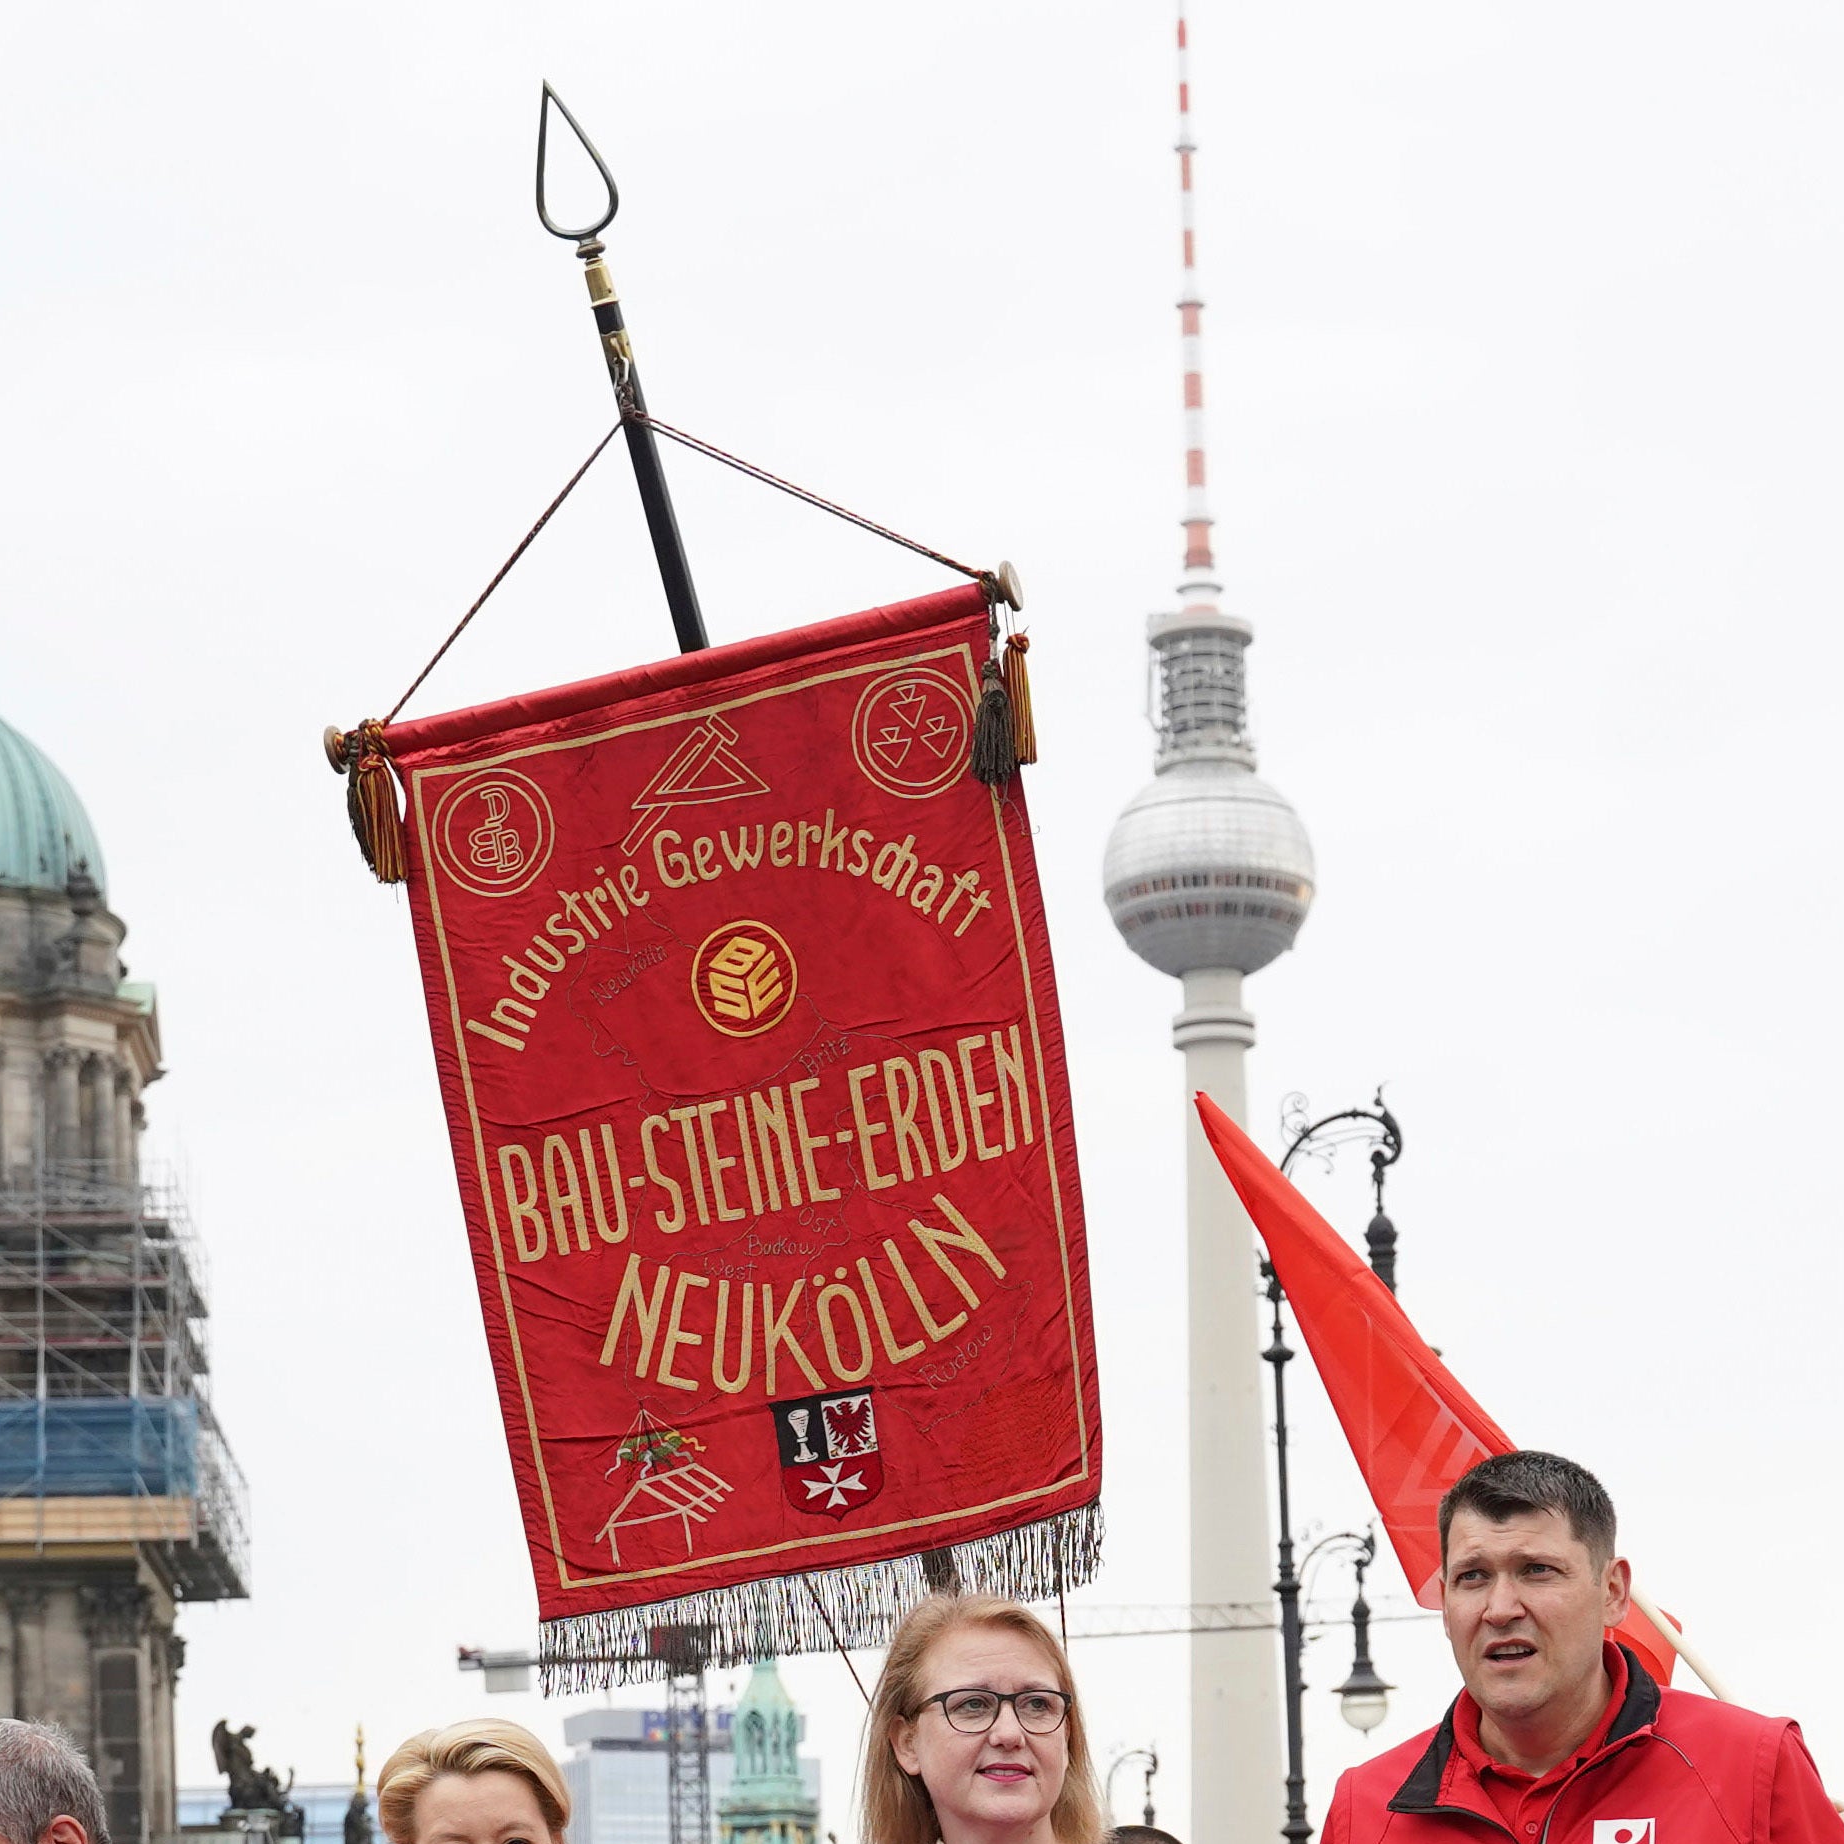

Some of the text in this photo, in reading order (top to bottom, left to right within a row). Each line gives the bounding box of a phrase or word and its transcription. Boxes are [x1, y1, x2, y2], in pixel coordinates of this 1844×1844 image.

[465, 807, 992, 1053] Industrie Gewerkschaft
[497, 1024, 1034, 1264] BAU-STEINE-ERDEN
[598, 1192, 1007, 1397] NEUKÖLLN
